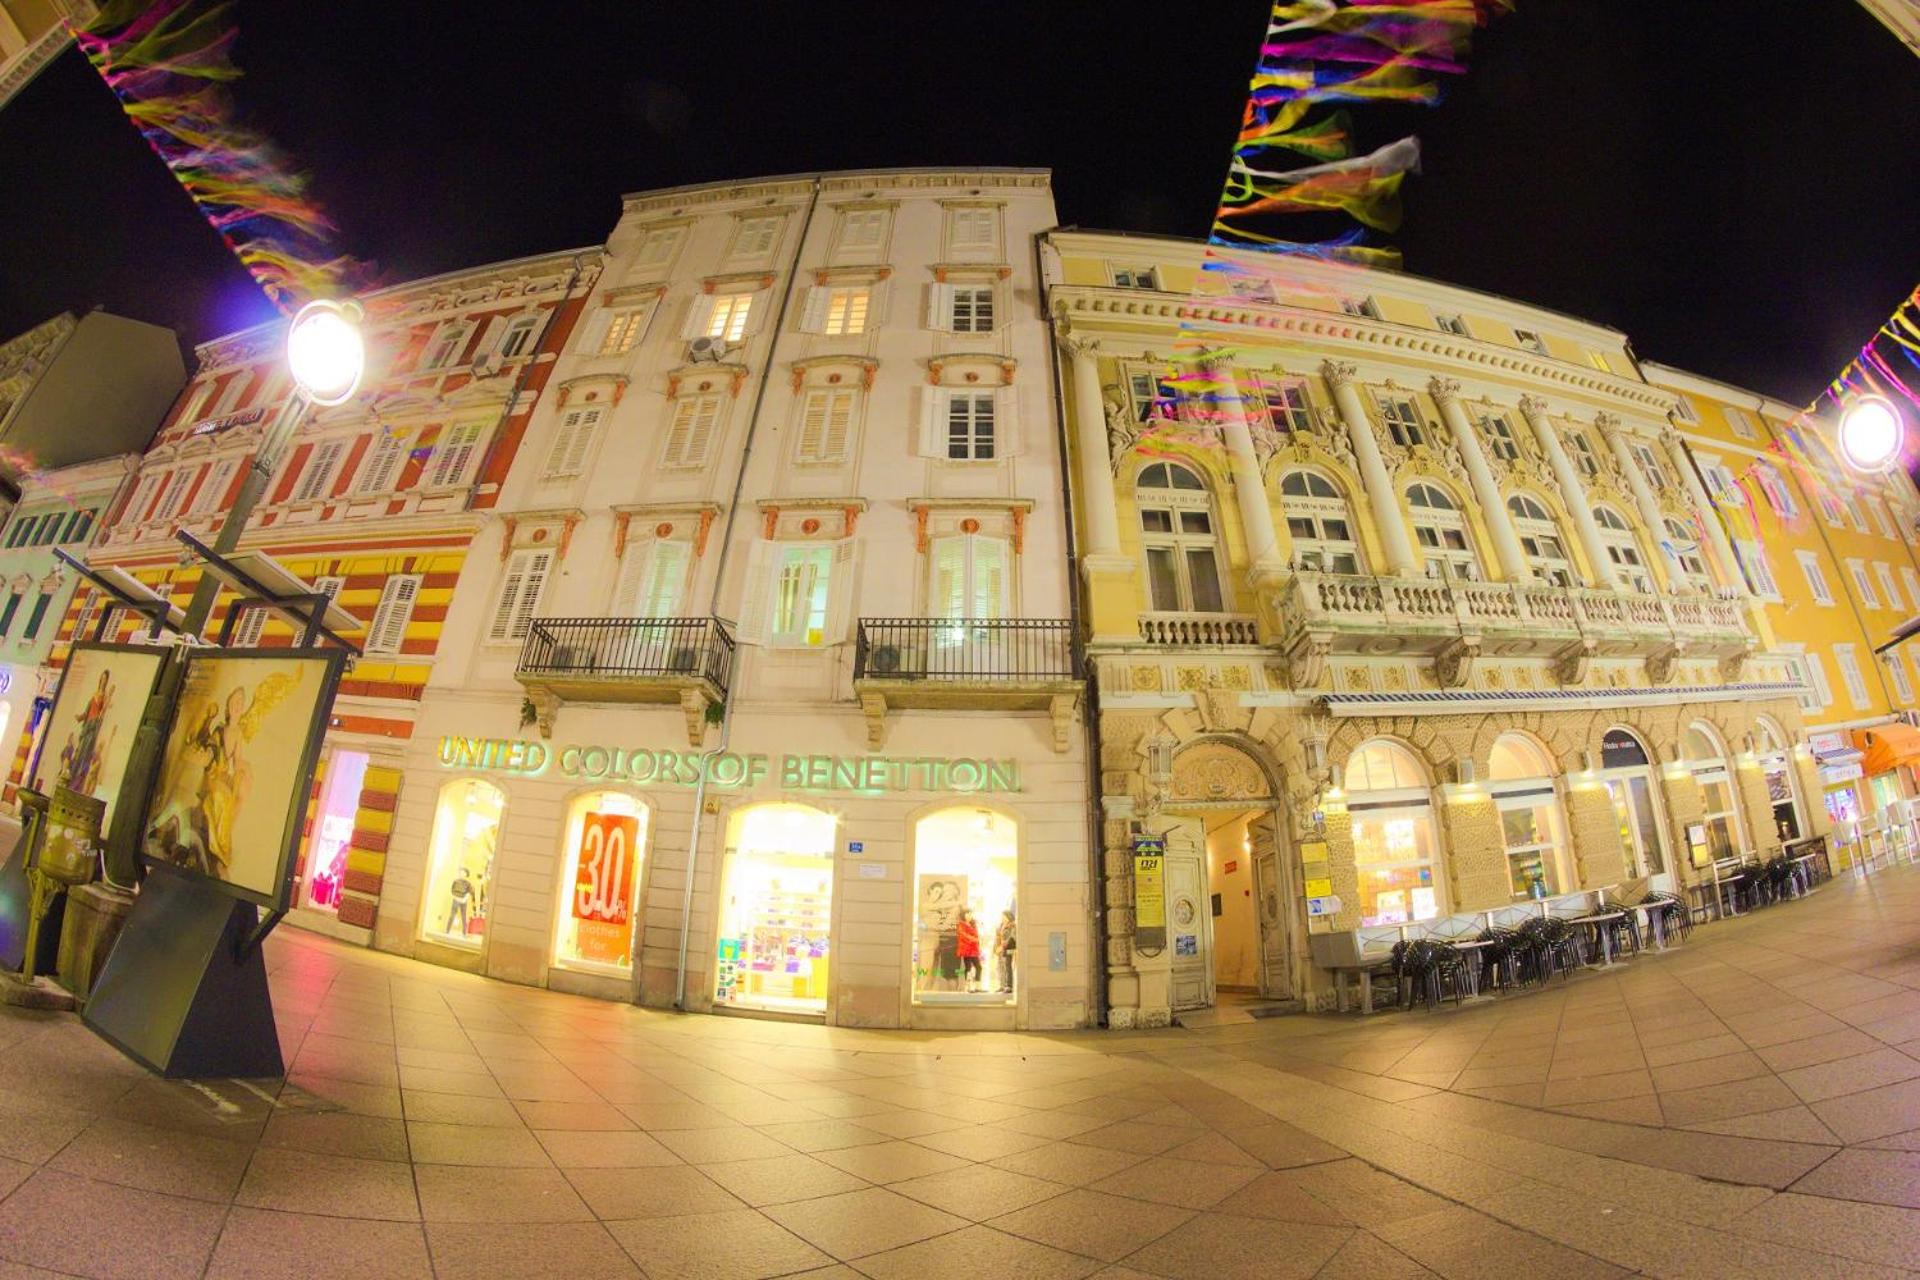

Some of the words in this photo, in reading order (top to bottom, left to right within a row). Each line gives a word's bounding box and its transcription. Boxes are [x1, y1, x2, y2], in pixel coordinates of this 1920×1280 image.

[439, 735, 546, 772] UNITED
[559, 744, 700, 785] COLORS
[710, 752, 769, 788] OF
[780, 753, 1023, 793] BENETTON
